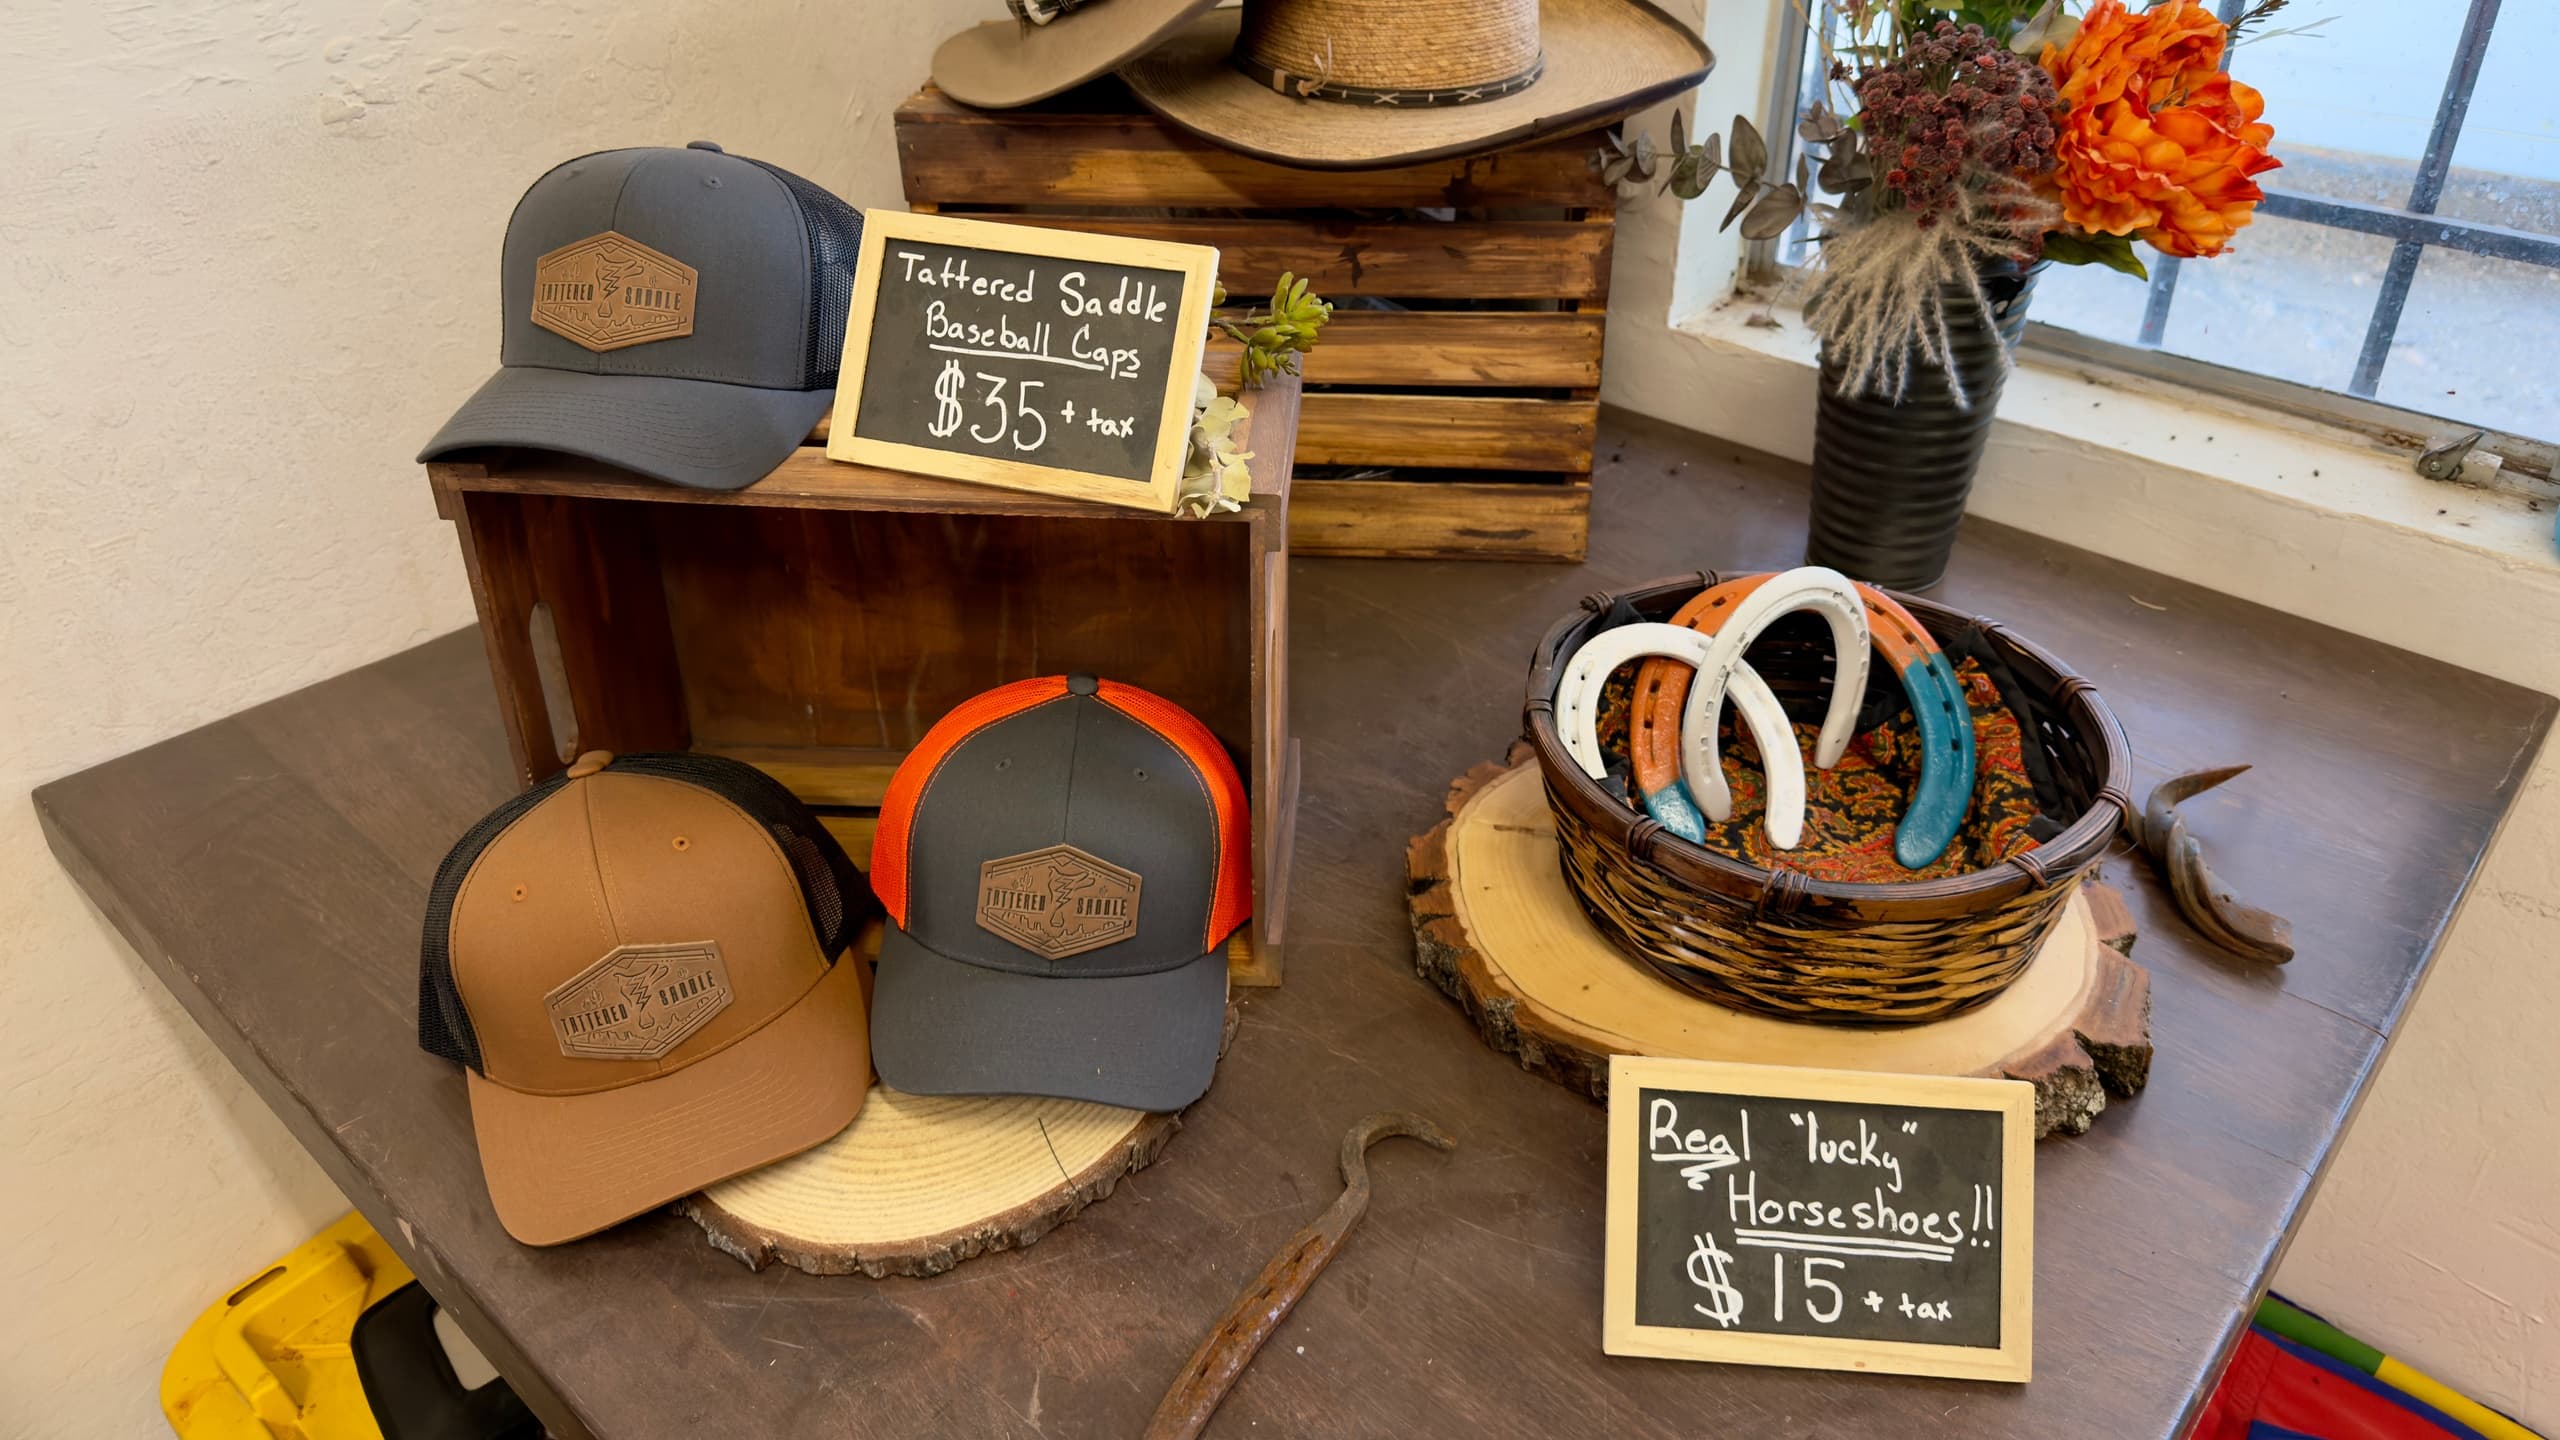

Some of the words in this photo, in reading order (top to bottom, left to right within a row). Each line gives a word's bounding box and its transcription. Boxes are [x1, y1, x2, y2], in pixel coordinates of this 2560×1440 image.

[541, 283, 594, 302] TATTERED
[625, 286, 681, 311] SADDLE
[898, 252, 1035, 303] Tattered
[1059, 271, 1168, 323] Saddle
[926, 300, 1049, 357] Baseball
[1071, 324, 1142, 379] Caps
[928, 359, 1047, 451] $35
[1086, 409, 1134, 438] tax
[986, 888, 1046, 912] TATTERED
[1076, 897, 1128, 917] SADDLE
[560, 1003, 629, 1035] TATTERED
[659, 970, 716, 1006] SADDLE
[1650, 1098, 1750, 1161] Real
[1729, 1170, 1993, 1248] Horseshoes!!
[1899, 1292, 1952, 1320] tax
